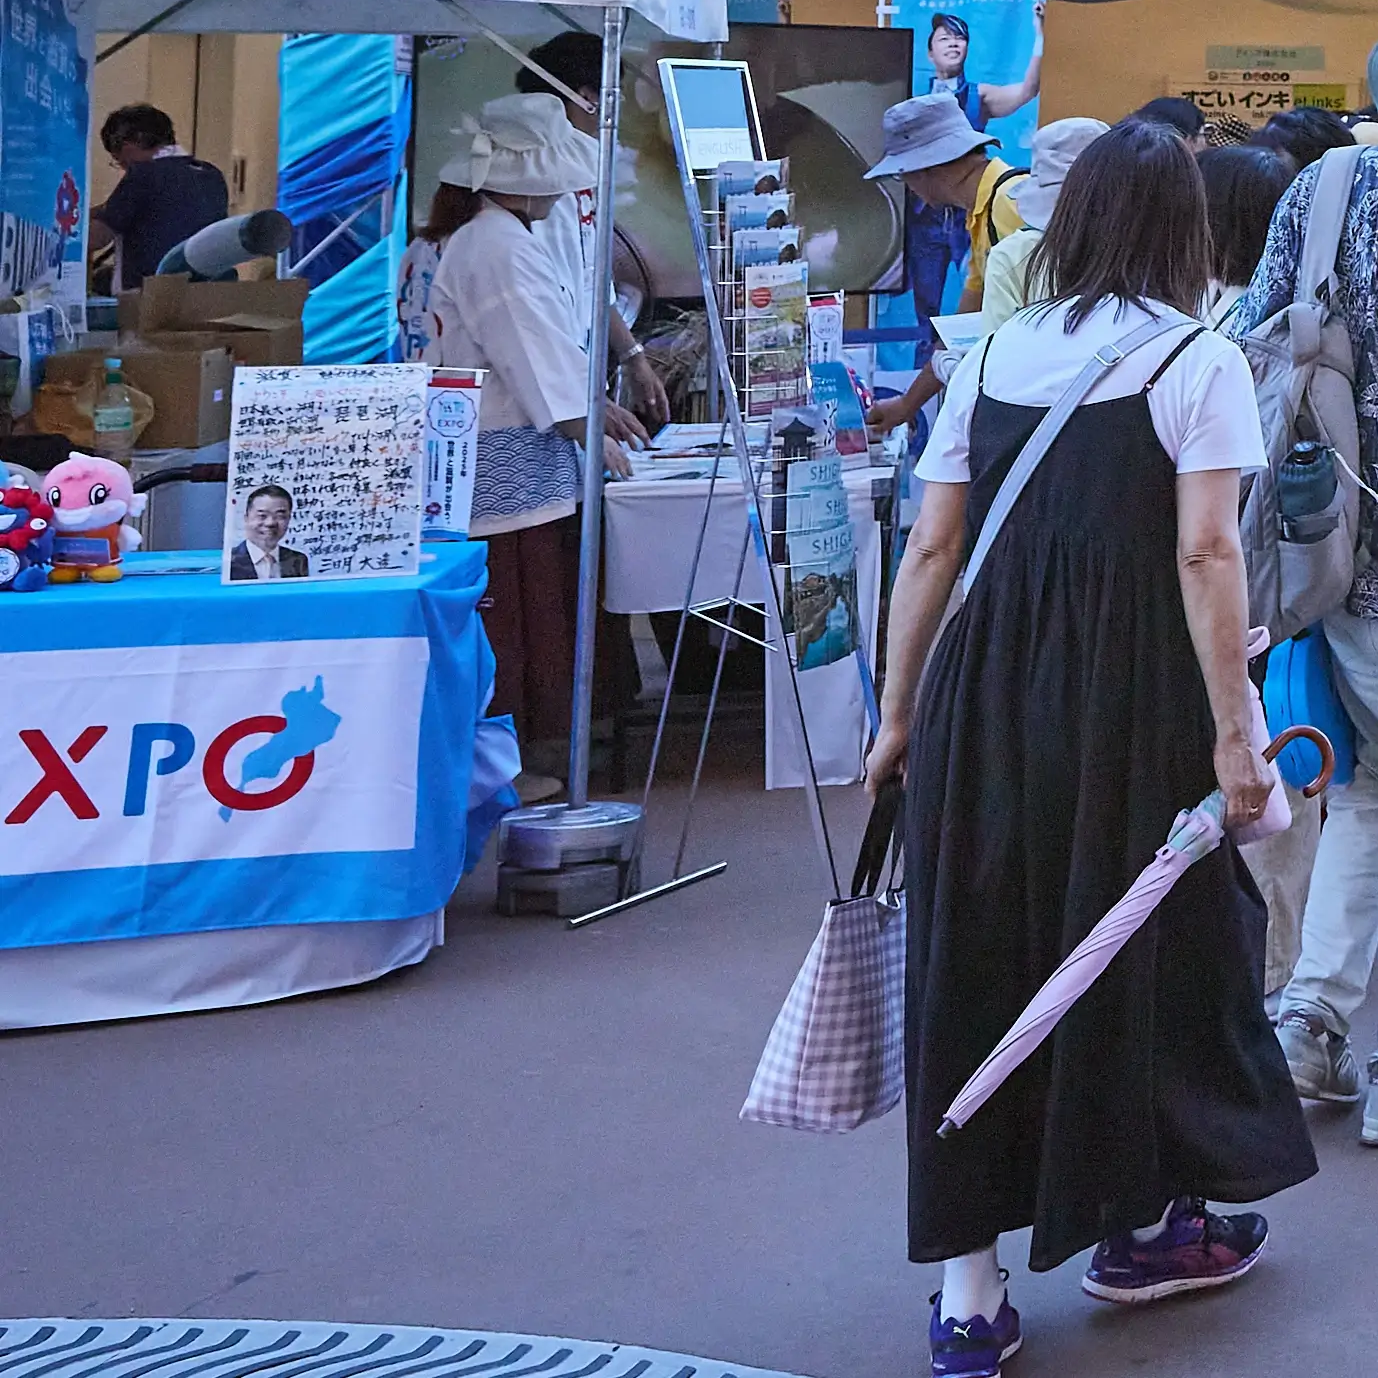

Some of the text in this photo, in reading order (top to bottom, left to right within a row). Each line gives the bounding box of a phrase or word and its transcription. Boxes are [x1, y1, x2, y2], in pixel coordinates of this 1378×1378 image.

[1238, 89, 1290, 109] インキ
[810, 463, 841, 481] SHIG
